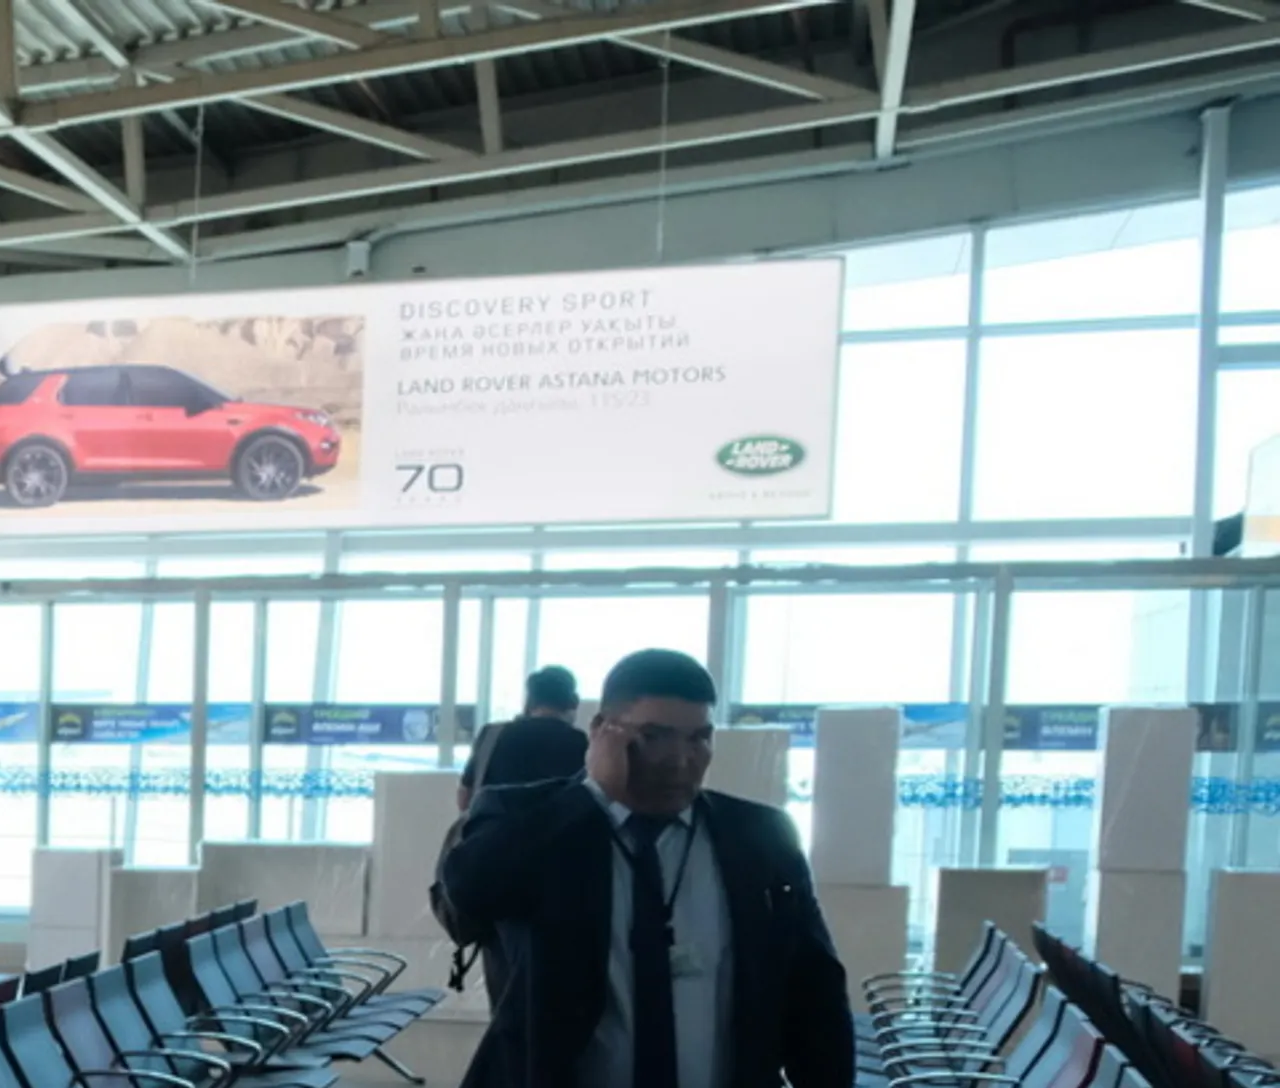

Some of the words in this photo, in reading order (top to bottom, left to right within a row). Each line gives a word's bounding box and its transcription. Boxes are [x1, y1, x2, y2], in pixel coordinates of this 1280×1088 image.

[399, 295, 551, 321] DISCOVERY
[562, 288, 654, 313] SPORT
[399, 342, 474, 362] ВРЕМЯ
[482, 338, 559, 358] НОВЫХ
[397, 377, 454, 396] LAND
[461, 373, 532, 393] ROVER
[538, 369, 625, 390] ASTANA
[632, 365, 727, 386] MOTORS
[394, 461, 466, 494] 70
